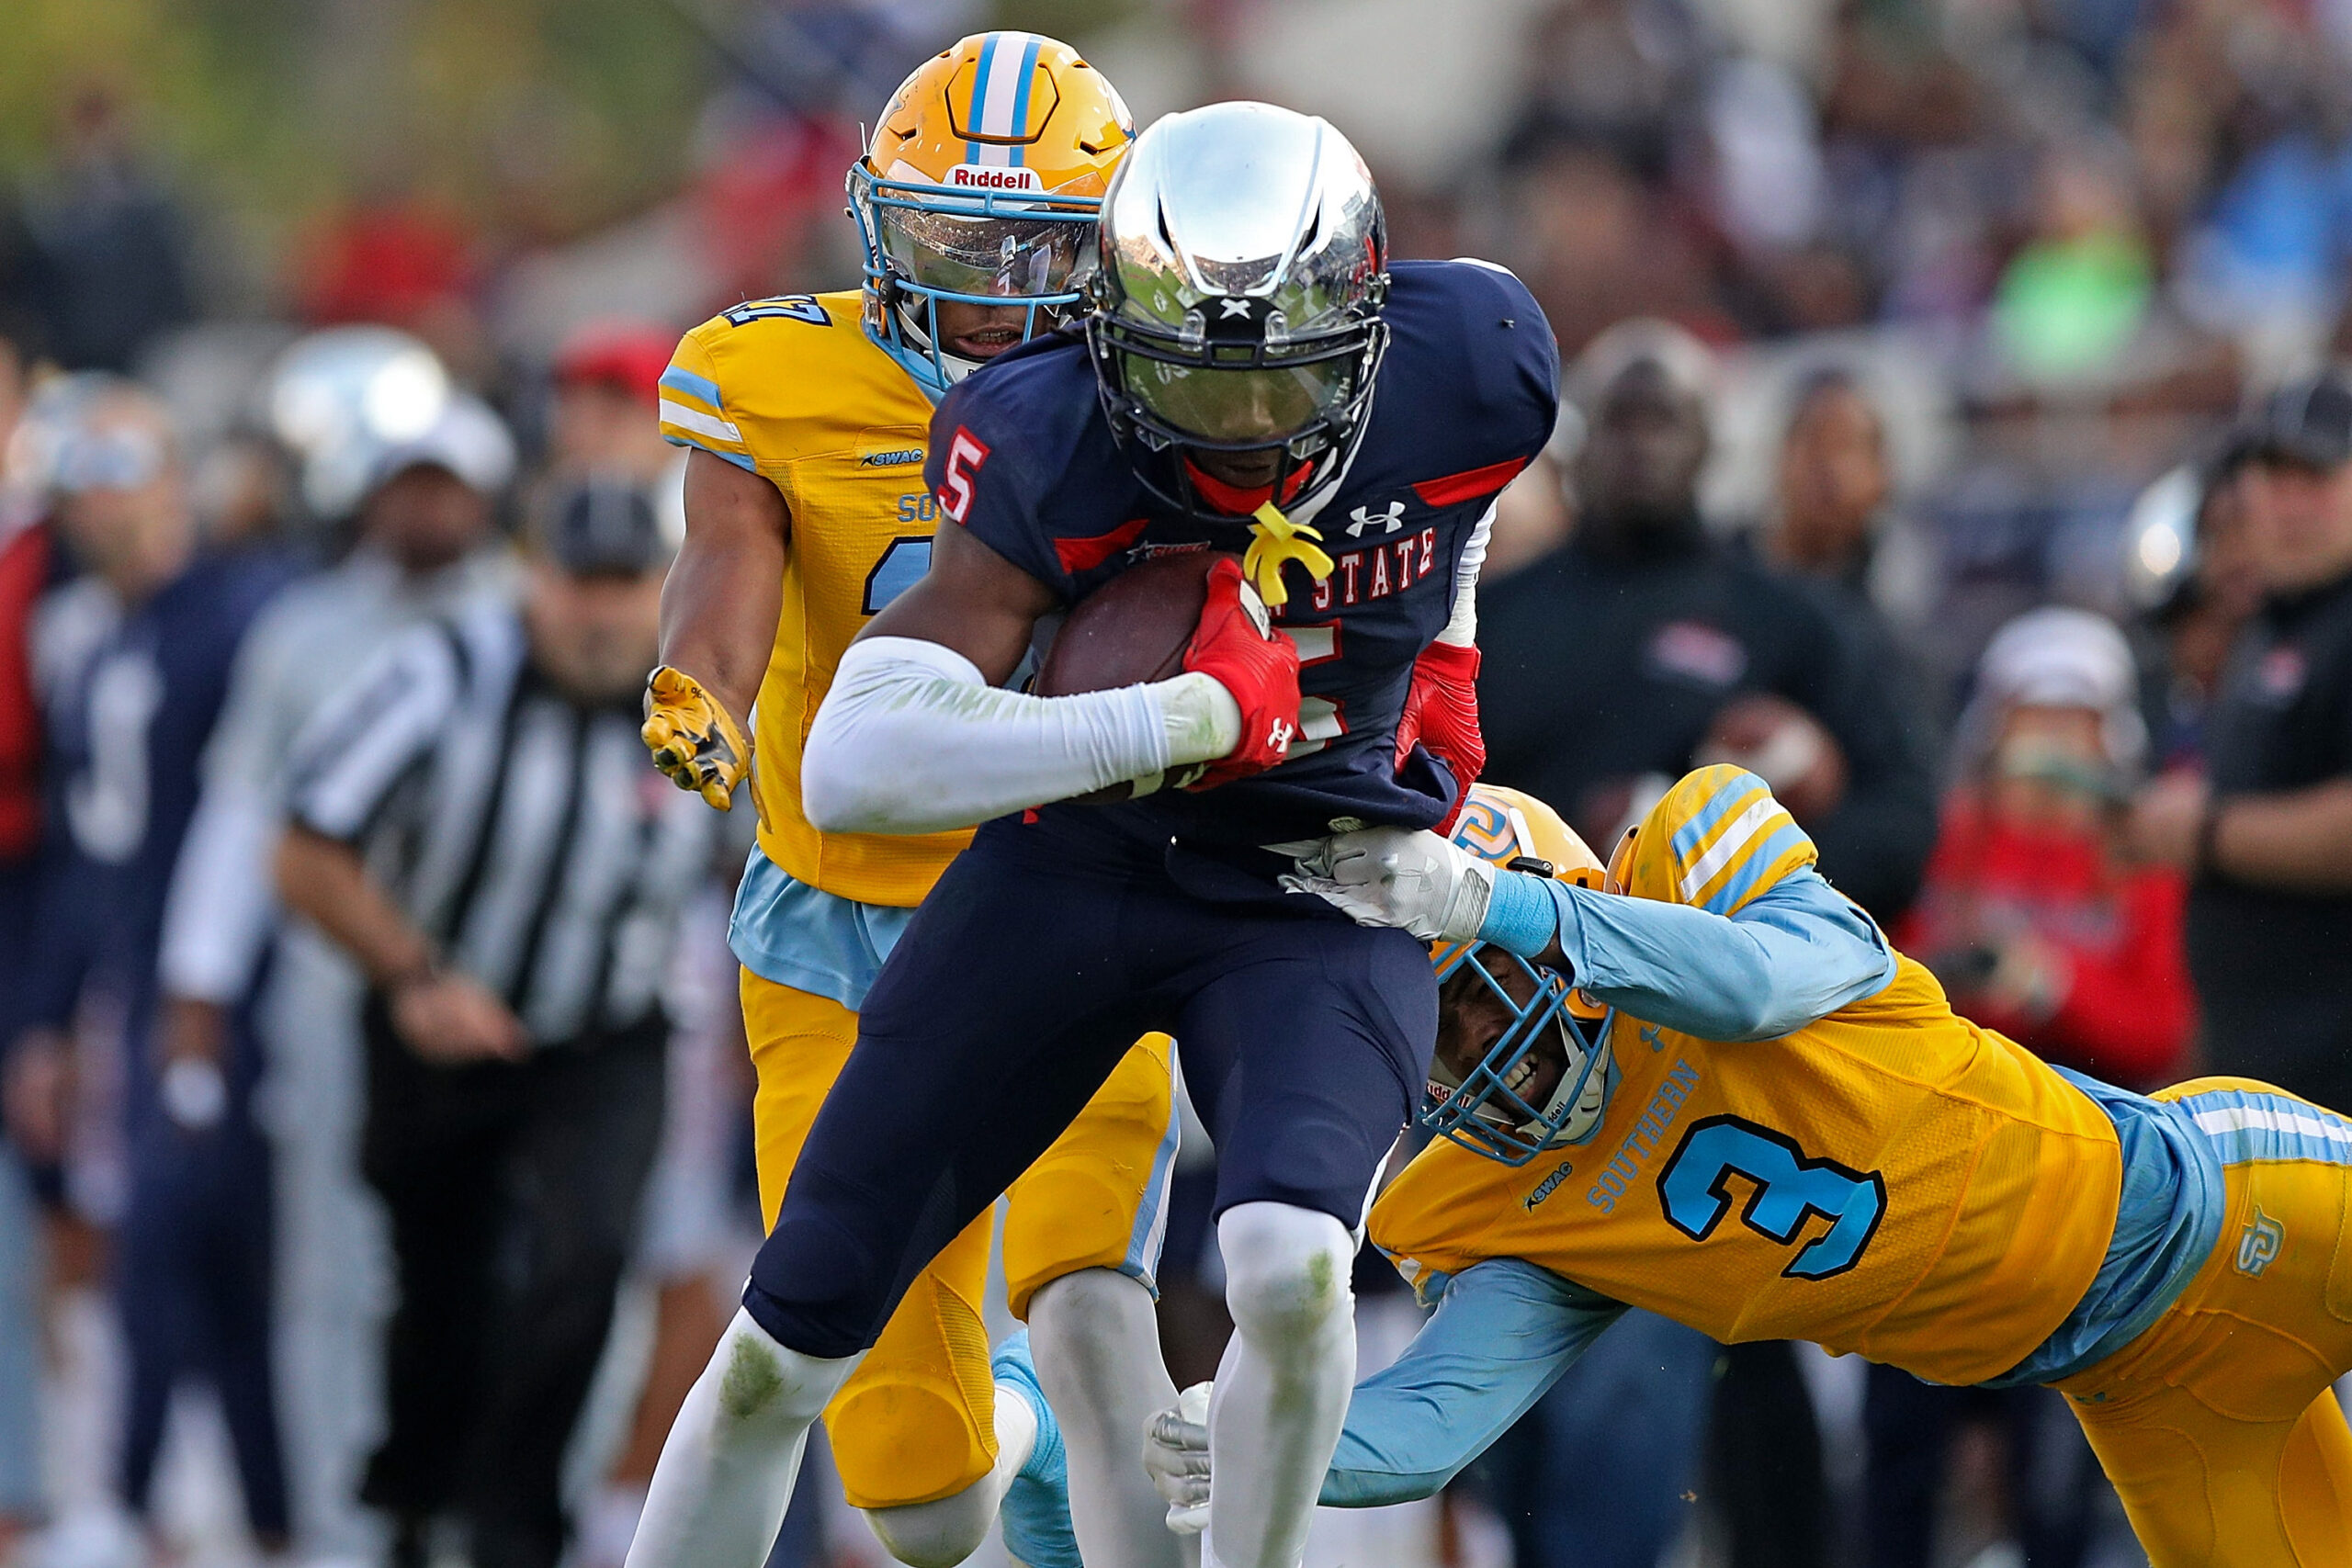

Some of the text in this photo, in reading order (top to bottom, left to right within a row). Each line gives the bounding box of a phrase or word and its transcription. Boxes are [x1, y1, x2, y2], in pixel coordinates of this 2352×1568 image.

[955, 168, 1031, 189] Riddell
[873, 448, 924, 467] SWAC
[936, 423, 991, 526] 5
[1312, 526, 1437, 613] STATE
[1426, 1082, 1471, 1110] iddll
[1587, 1058, 1700, 1213] SOUTHERN
[1532, 1161, 1573, 1203] SWAC
[1657, 1113, 1887, 1281] 3
